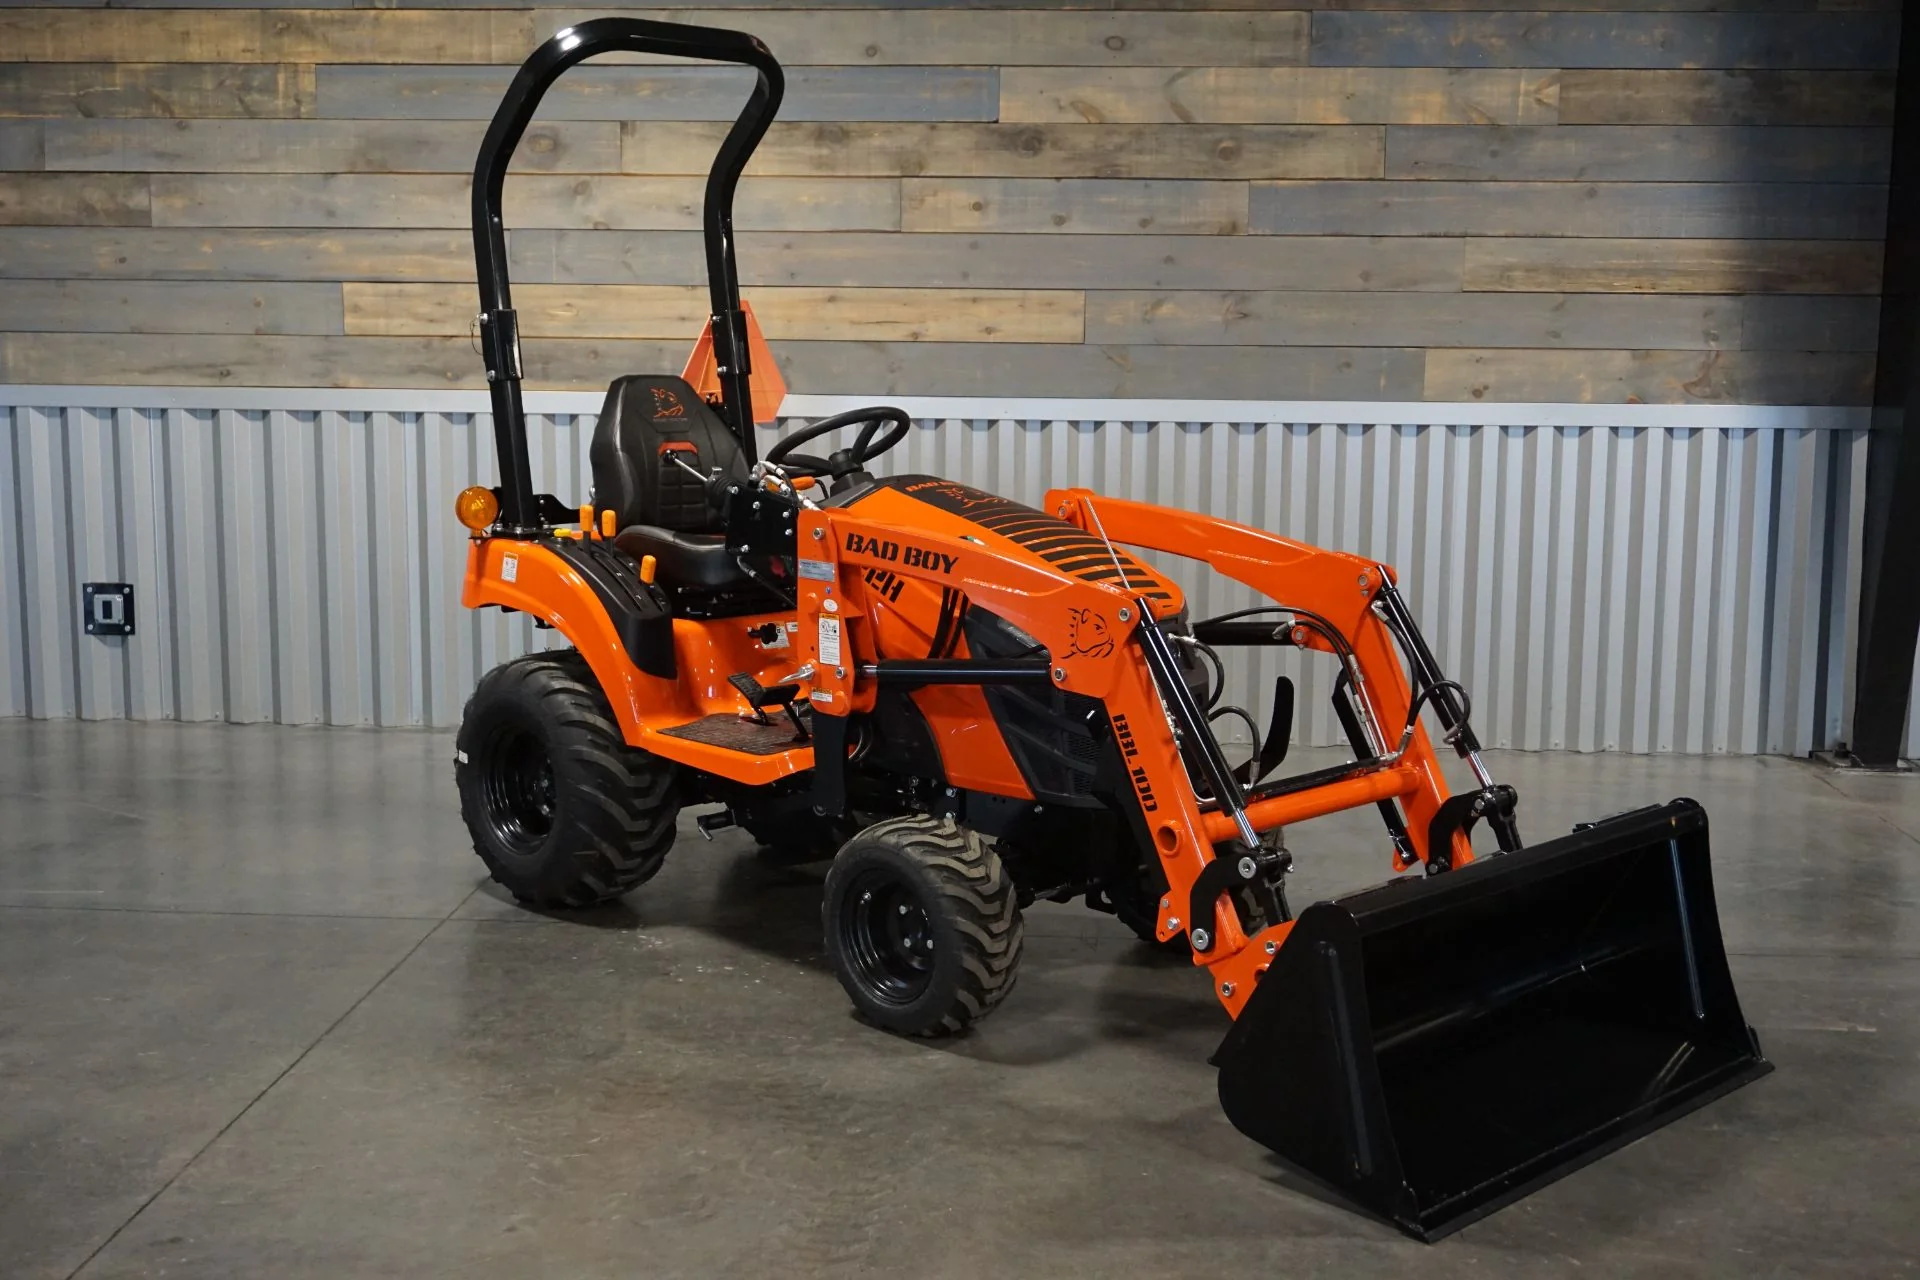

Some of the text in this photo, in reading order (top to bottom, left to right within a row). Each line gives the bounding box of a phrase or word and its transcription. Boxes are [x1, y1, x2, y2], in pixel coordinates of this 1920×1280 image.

[845, 532, 959, 574] BAD BOY
[1112, 713, 1158, 812] BBL 100
